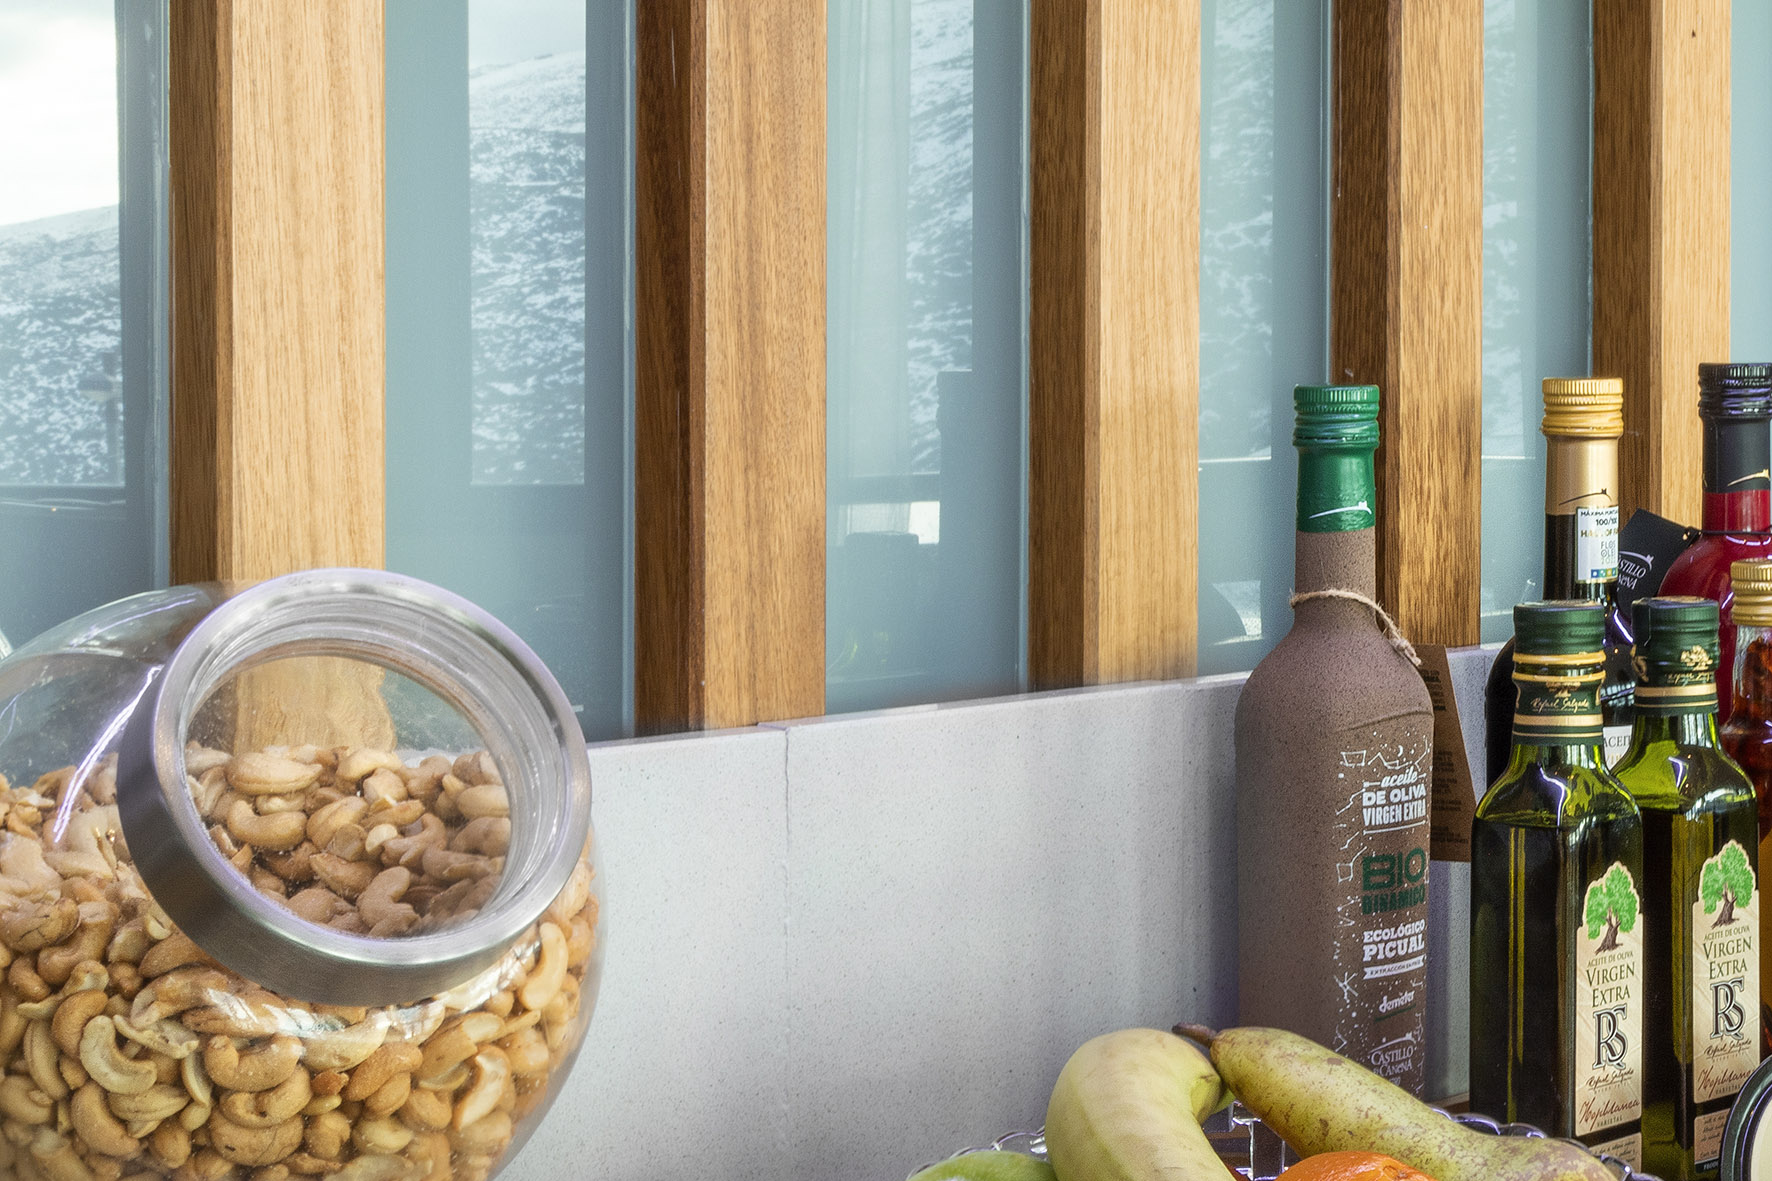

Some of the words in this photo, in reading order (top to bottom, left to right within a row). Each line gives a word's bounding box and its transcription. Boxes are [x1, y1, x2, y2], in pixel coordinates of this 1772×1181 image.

[1380, 766, 1418, 788] aceite
[1362, 790, 1386, 806] DE
[1389, 783, 1427, 804] OLIVA
[1362, 802, 1402, 826] VIRGEN
[1403, 798, 1426, 821] EXTRA
[1362, 848, 1426, 891] BIO
[1363, 919, 1426, 944] ECOLÓGICO
[1704, 930, 1724, 941] ACEITE
[1724, 928, 1732, 938] DE
[1733, 925, 1750, 936] OLIVA
[1362, 934, 1425, 962] PICUAL
[1588, 956, 1607, 968] ACEITE
[1608, 954, 1616, 964] DE
[1617, 952, 1634, 962] OLIVA
[1702, 936, 1752, 961] VIRGEN
[1586, 962, 1635, 988] VIRGEN
[1710, 958, 1748, 980] EXTRA
[1379, 990, 1415, 1013] demeter
[1592, 984, 1630, 1008] EXTRA
[1710, 976, 1746, 1040] RS
[1592, 1004, 1628, 1070] RS
[1371, 1045, 1414, 1066] CASTILLO
[1698, 1066, 1753, 1098] Hojiblanc
